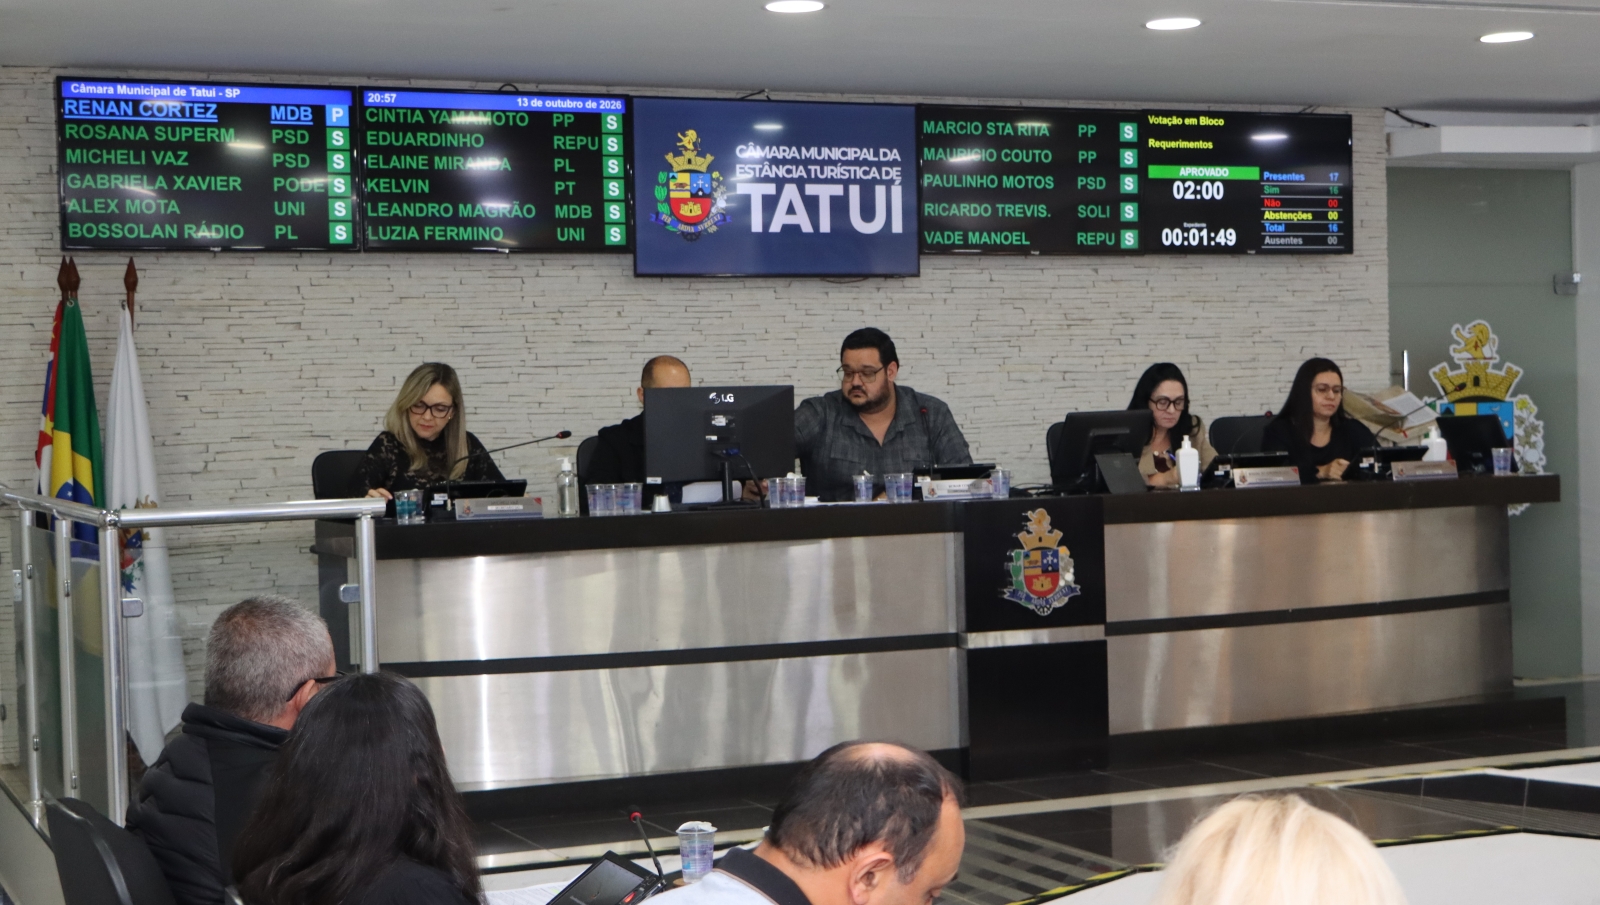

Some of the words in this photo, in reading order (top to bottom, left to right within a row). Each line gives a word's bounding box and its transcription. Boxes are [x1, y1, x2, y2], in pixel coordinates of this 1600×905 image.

[71, 83, 115, 94] Câmara
[117, 84, 170, 97] Municipal
[173, 86, 186, 96] de
[225, 88, 240, 99] SP
[368, 93, 396, 103] 20:57
[517, 98, 528, 107] 13
[531, 98, 543, 107] de
[545, 98, 582, 108] outubro
[586, 100, 597, 109] de
[599, 100, 621, 109] 2026
[64, 100, 133, 117] RENAN
[139, 102, 217, 119] CORTEZ
[271, 106, 312, 121] MDB
[332, 108, 343, 122] P
[366, 108, 424, 124] CINTIA
[428, 110, 528, 126] YAMAMOTO
[553, 114, 574, 127] PP
[607, 116, 617, 130] S
[1148, 116, 1182, 126] Votação
[1200, 117, 1224, 126] Bloco
[65, 124, 149, 140] ROSANA
[272, 130, 309, 144] PSD
[332, 131, 343, 145] S
[924, 121, 982, 135] MARCIO
[987, 122, 1013, 135] STA
[1018, 123, 1049, 136] RITA
[1079, 125, 1096, 137] PP
[1124, 126, 1133, 138] S
[367, 131, 484, 148] EDUARDINHO
[553, 136, 598, 150] REPU
[607, 138, 618, 152] S
[1149, 139, 1213, 149] Requerimentos
[67, 149, 145, 165] MICHELI
[152, 151, 188, 166] VAZ
[273, 153, 310, 168] PSD
[333, 155, 344, 169] S
[736, 142, 800, 160] CÂMARA
[801, 146, 877, 161] MUNICIPAL
[880, 148, 900, 161] DA
[924, 148, 996, 162] MAURICIO
[1001, 150, 1052, 163] COUTO
[1079, 152, 1096, 163] PP
[1124, 152, 1133, 164] S
[368, 155, 428, 169] ELAINE
[434, 156, 511, 171] MIRANDA
[555, 159, 575, 172] PL
[608, 160, 619, 174] S
[736, 161, 806, 178] ESTÂNCIA
[808, 163, 880, 179] TURÍSTICA
[882, 167, 901, 180] DE
[1179, 167, 1229, 177] APROVADO
[67, 174, 168, 190] GABRIELA
[174, 176, 242, 191] XAVIER
[273, 178, 324, 192] PODE
[334, 179, 345, 193] S
[924, 174, 998, 188] PAULINHO
[1003, 176, 1054, 189] MOTOS
[1078, 177, 1106, 189] PSD
[1124, 177, 1134, 190] S
[1264, 172, 1305, 181] Presentes
[1329, 173, 1338, 181] 17
[367, 179, 429, 193] KELVIN
[555, 182, 575, 195] PT
[609, 183, 619, 196] S
[1173, 181, 1224, 200] 02:00
[1264, 185, 1279, 194] Sim
[1329, 186, 1338, 194] 16
[67, 199, 118, 214] ALEX
[126, 200, 180, 215] MOTA
[275, 202, 305, 216] UNI
[335, 202, 346, 216] S
[368, 203, 453, 217] LEANDRO
[459, 201, 536, 219] MAGRÃO
[555, 205, 592, 218] MDB
[610, 206, 620, 219] S
[736, 178, 903, 234] TATUÍ
[925, 203, 991, 216] RICARDO
[996, 204, 1050, 217] TREVIS.
[1078, 206, 1109, 218] SOLI
[1125, 206, 1134, 218] S
[1264, 199, 1280, 207] Não
[1328, 199, 1338, 208] 00
[1264, 211, 1312, 221] Abstenções
[1328, 212, 1338, 220] 00
[69, 223, 177, 239] BOSSOLAN
[184, 220, 244, 239] RÁDIO
[276, 226, 298, 239] PL
[335, 226, 346, 240] S
[368, 226, 419, 240] LUZIA
[424, 227, 503, 241] FERMINO
[557, 228, 584, 241] UNI
[610, 228, 621, 242] S
[1264, 223, 1285, 232] Total
[1328, 224, 1338, 232] 16
[925, 232, 963, 244] VADE
[968, 232, 1030, 245] MANOEL
[1077, 233, 1115, 245] REPU
[1125, 233, 1134, 245] S
[1162, 228, 1236, 246] 00:01:49
[1265, 236, 1302, 245] Ausentes
[722, 394, 734, 402] LG
